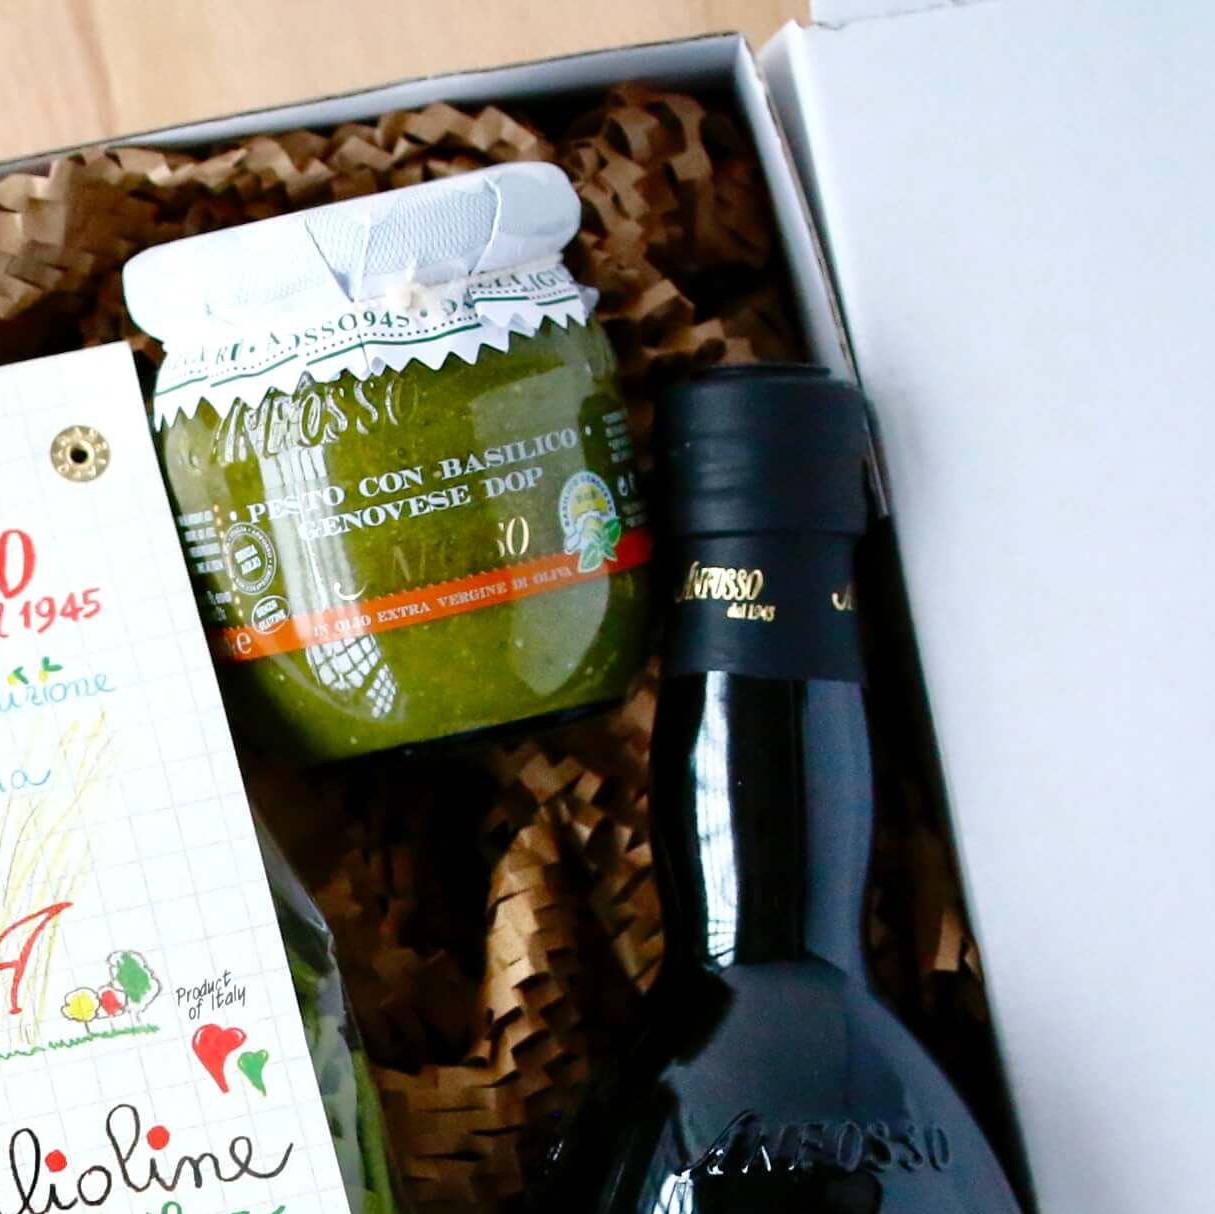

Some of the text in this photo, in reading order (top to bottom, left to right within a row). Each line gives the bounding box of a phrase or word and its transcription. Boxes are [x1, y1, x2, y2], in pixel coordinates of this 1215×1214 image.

[246, 485, 346, 525] PESTO
[359, 466, 424, 497] CON
[439, 427, 579, 480] BASILICO
[297, 484, 472, 541] GENOVESE
[483, 466, 544, 499] DOP
[19, 587, 102, 634] 1945
[378, 603, 432, 624] EXTRA
[437, 582, 509, 607] VERGINE
[533, 566, 573, 586] OLIVA
[175, 969, 232, 1008] Product
[188, 984, 246, 1020] of Italy
